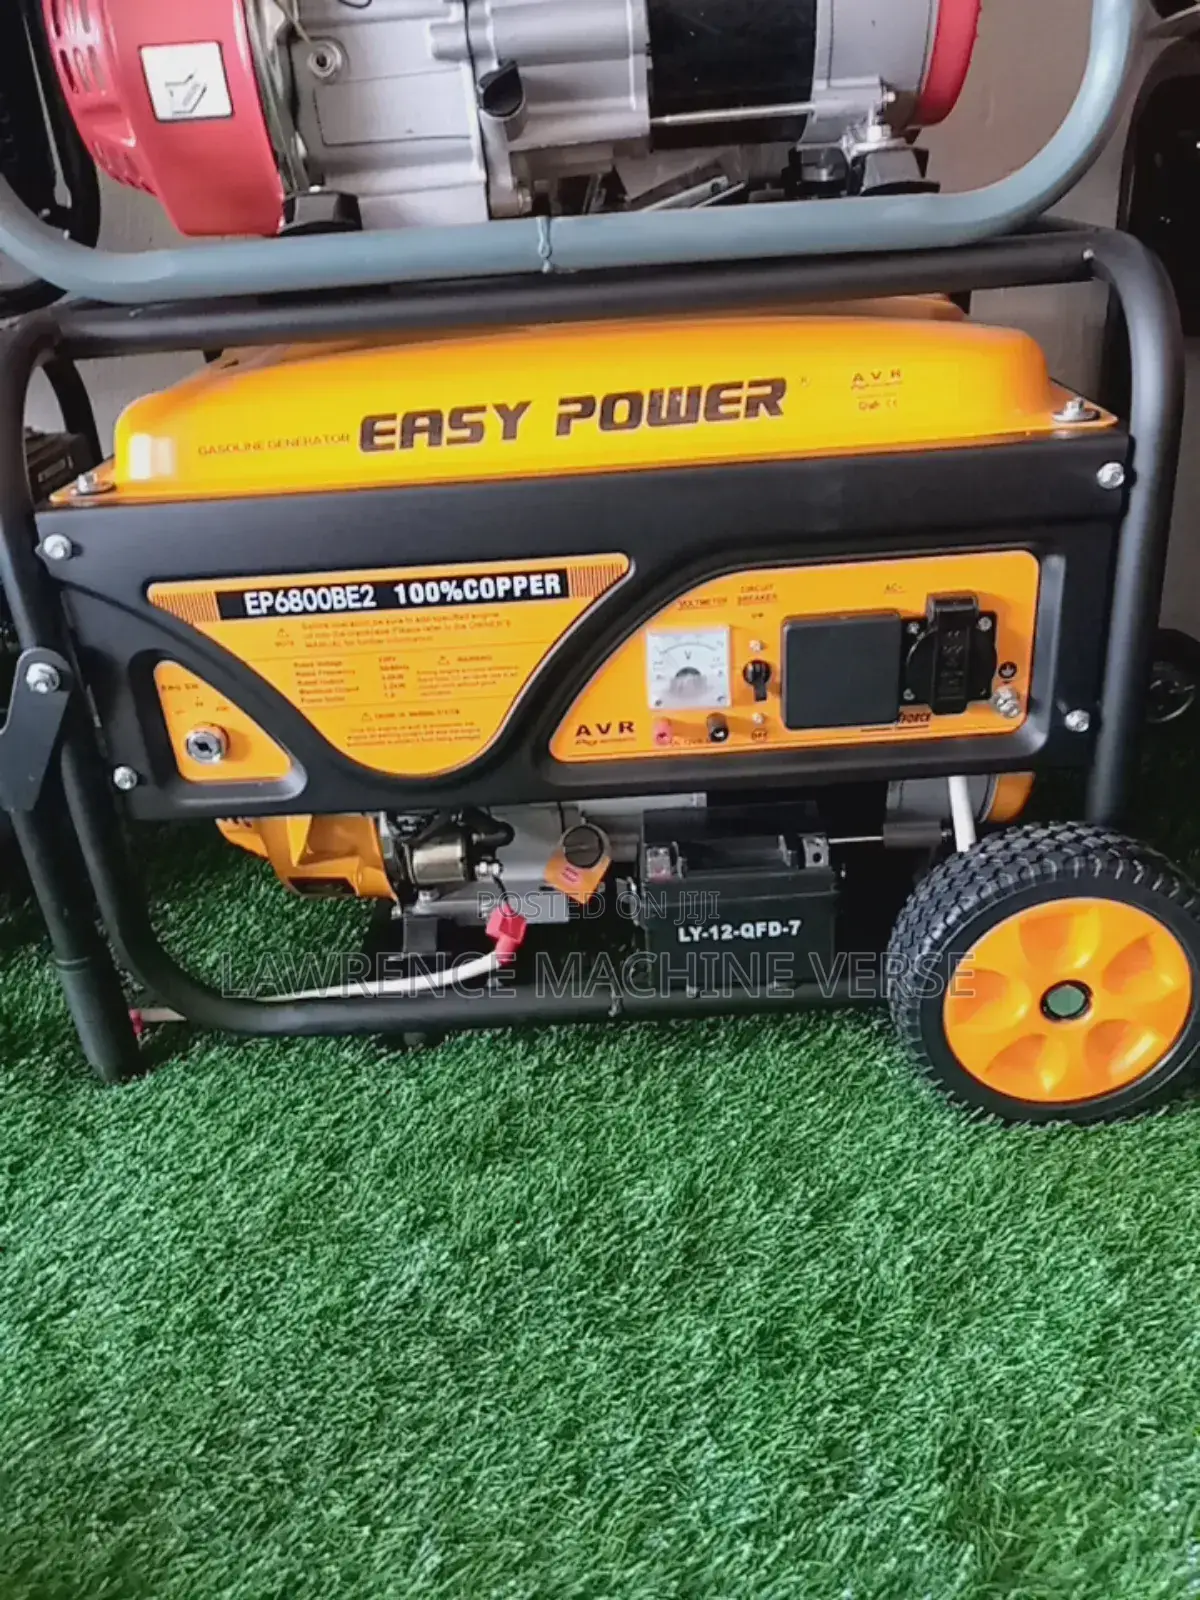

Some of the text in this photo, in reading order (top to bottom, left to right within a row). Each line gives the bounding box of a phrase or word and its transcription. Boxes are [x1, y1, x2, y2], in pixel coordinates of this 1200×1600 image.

[359, 377, 787, 452] EASY POWER
[243, 573, 562, 616] EP6800BE2 100%COPPER
[678, 919, 802, 942] LY-12-QFD-7
